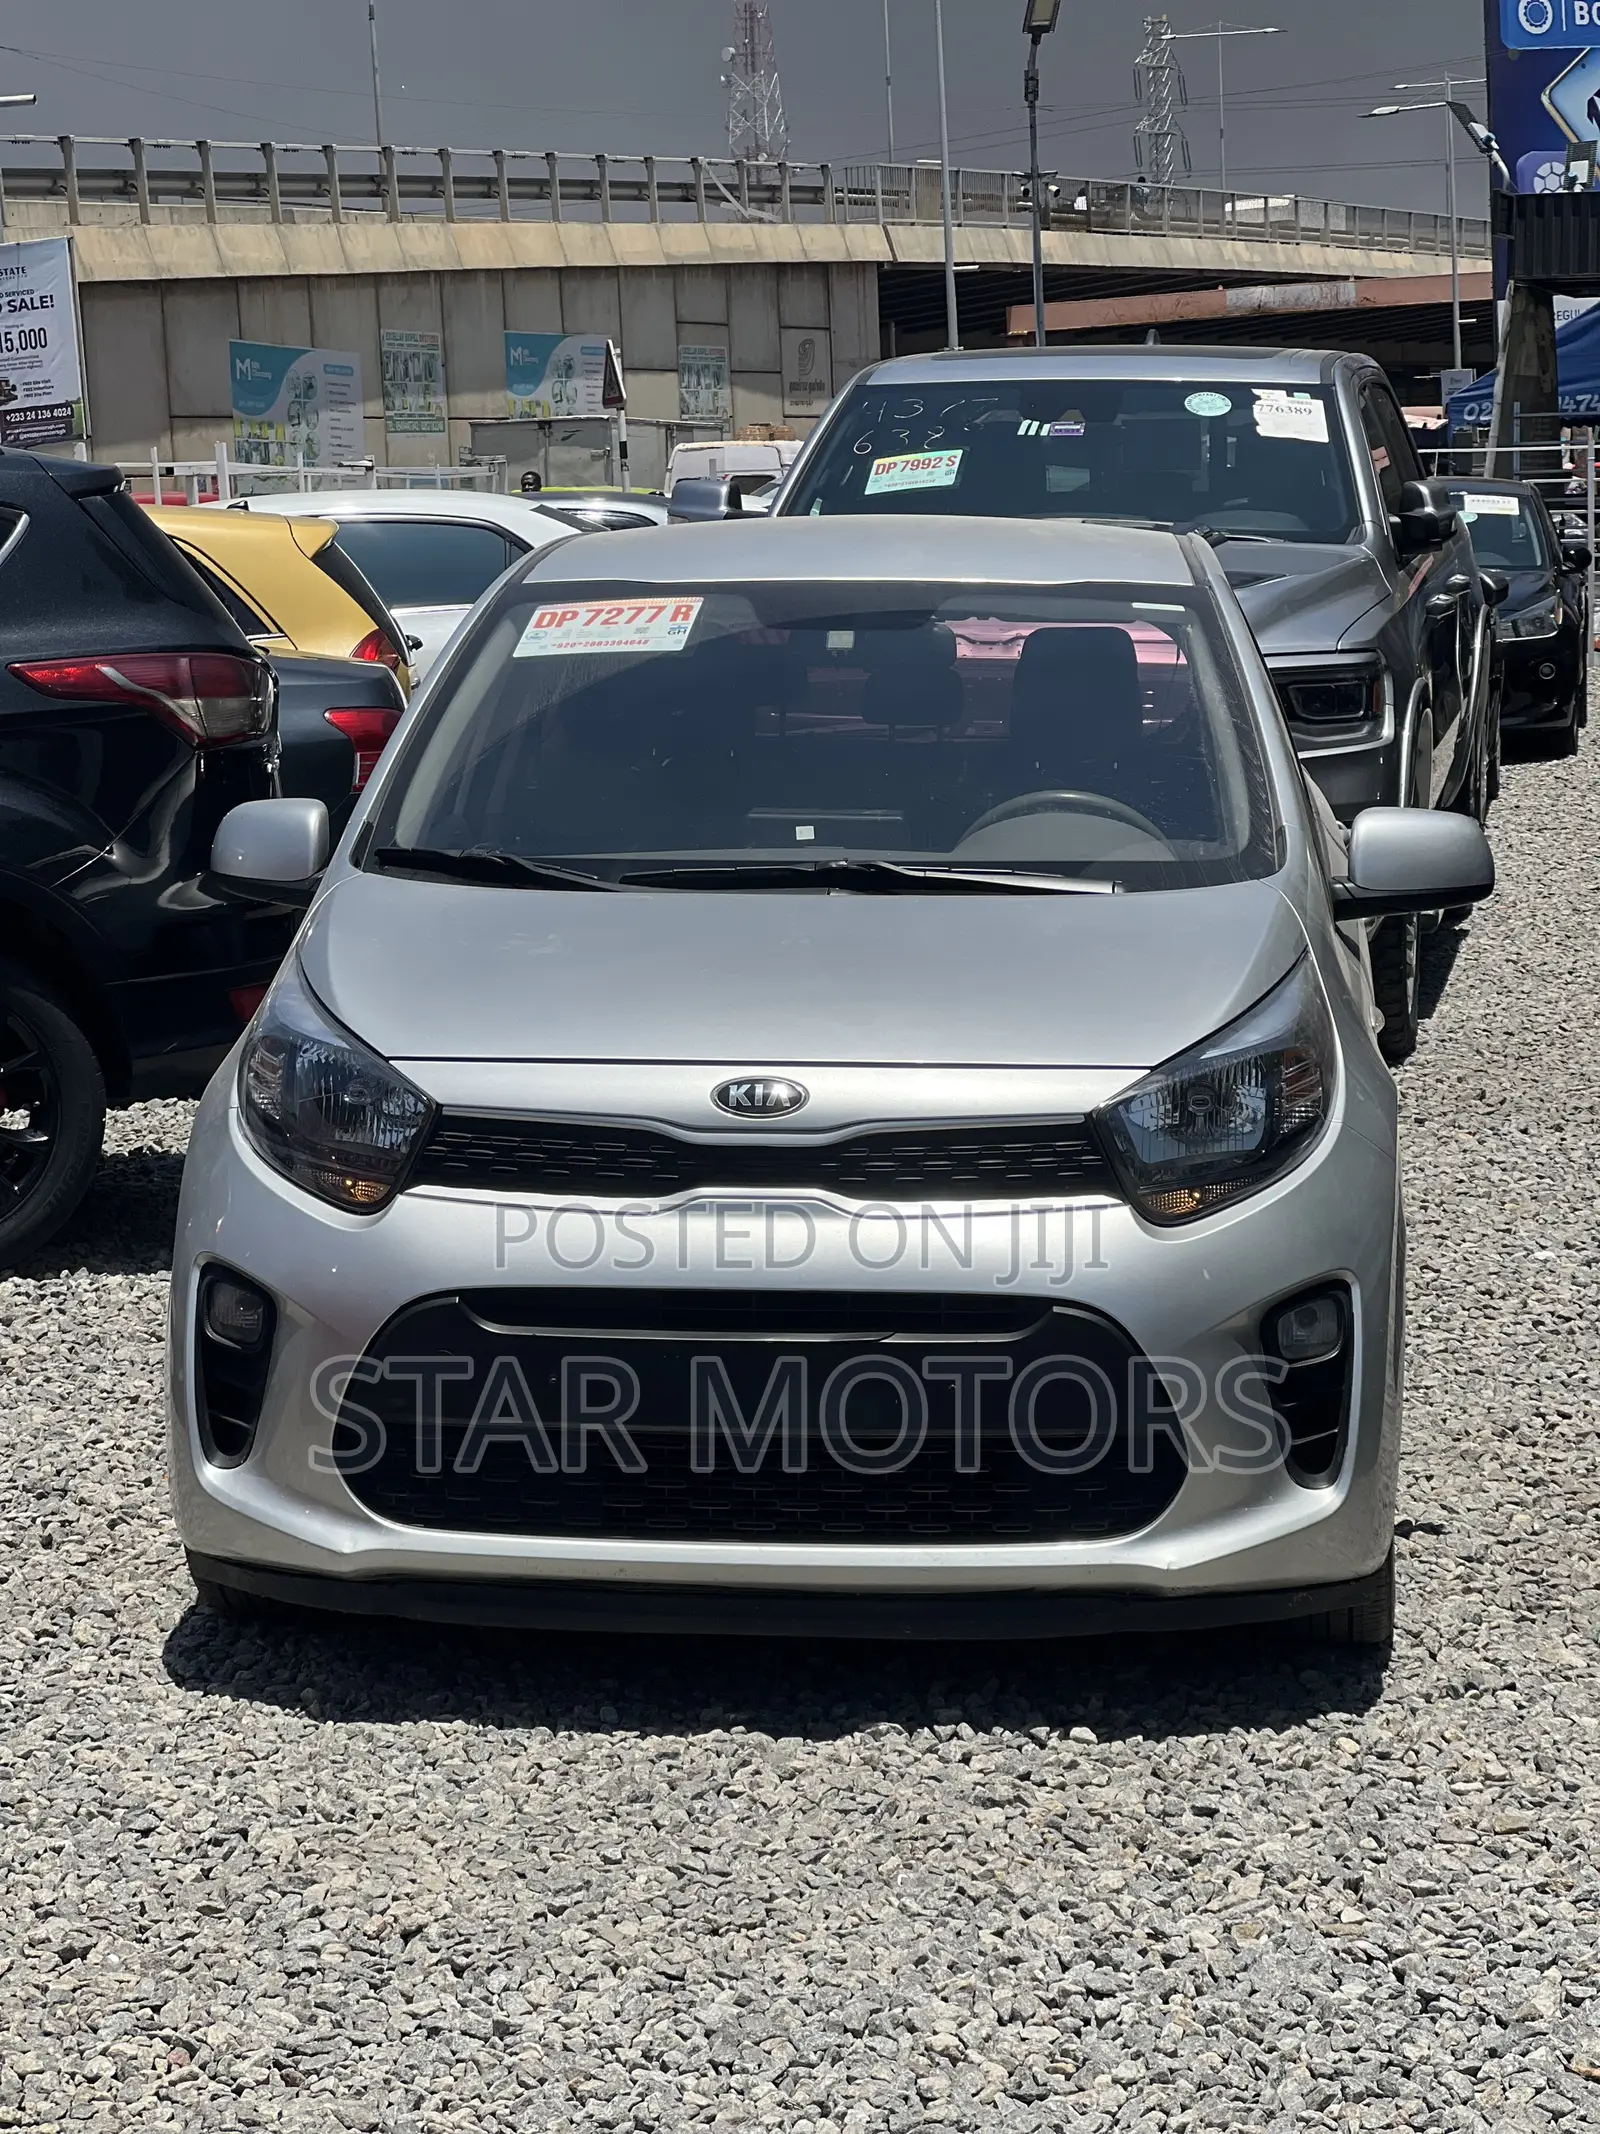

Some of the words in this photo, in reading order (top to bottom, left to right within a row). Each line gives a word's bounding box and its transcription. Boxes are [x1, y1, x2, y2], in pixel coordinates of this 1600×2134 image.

[4, 288, 35, 298] SERVICED
[7, 294, 55, 314] SALE!
[6, 412, 25, 422] +233
[26, 410, 36, 420] 24
[38, 409, 52, 419] 136
[53, 406, 72, 417] 4024
[1255, 403, 1313, 416] 776389
[874, 461, 898, 476] DP
[900, 456, 944, 473] 7992
[945, 454, 958, 468] S
[533, 608, 580, 629] DP
[582, 604, 668, 627] 7277
[669, 603, 695, 623] R
[728, 1083, 791, 1107] KIA
